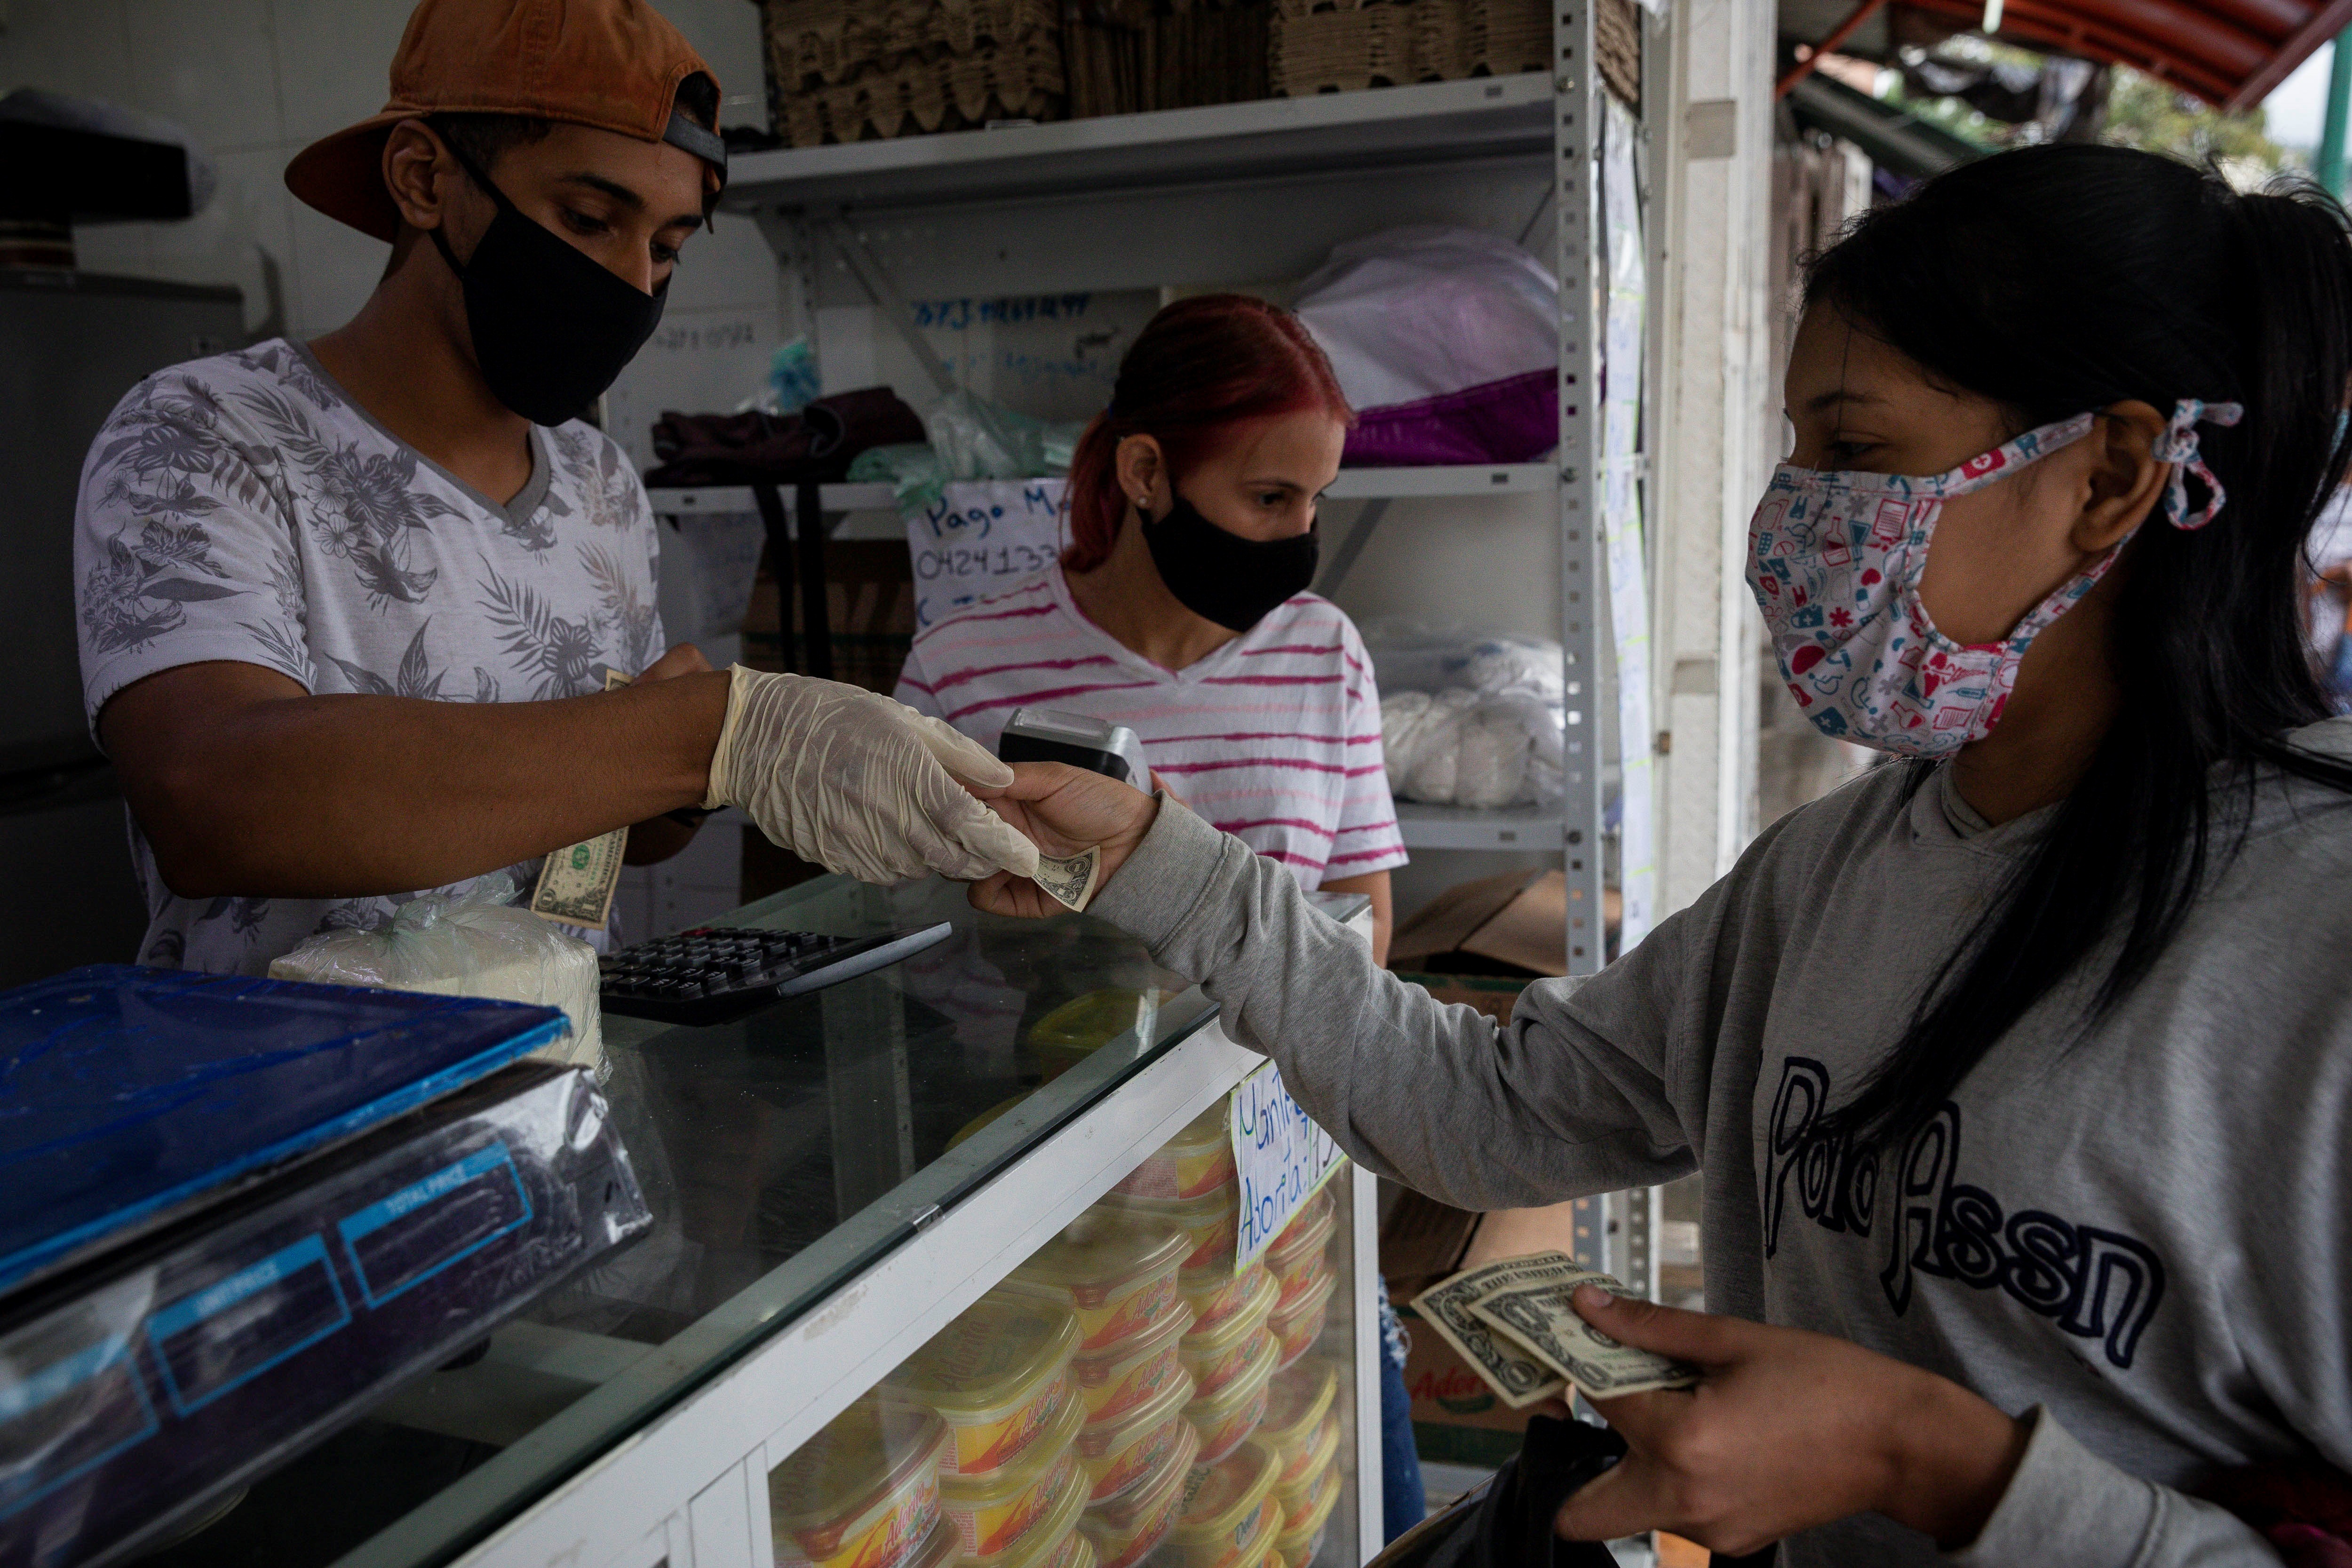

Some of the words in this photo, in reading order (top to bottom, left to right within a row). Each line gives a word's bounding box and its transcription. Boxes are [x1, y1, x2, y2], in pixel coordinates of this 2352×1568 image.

[926, 495, 1004, 539] Pago
[385, 1186, 429, 1216] TOTAL
[428, 1163, 467, 1193] PRICE
[1765, 1056, 1881, 1259] Polo
[1880, 1100, 2165, 1369] Assn
